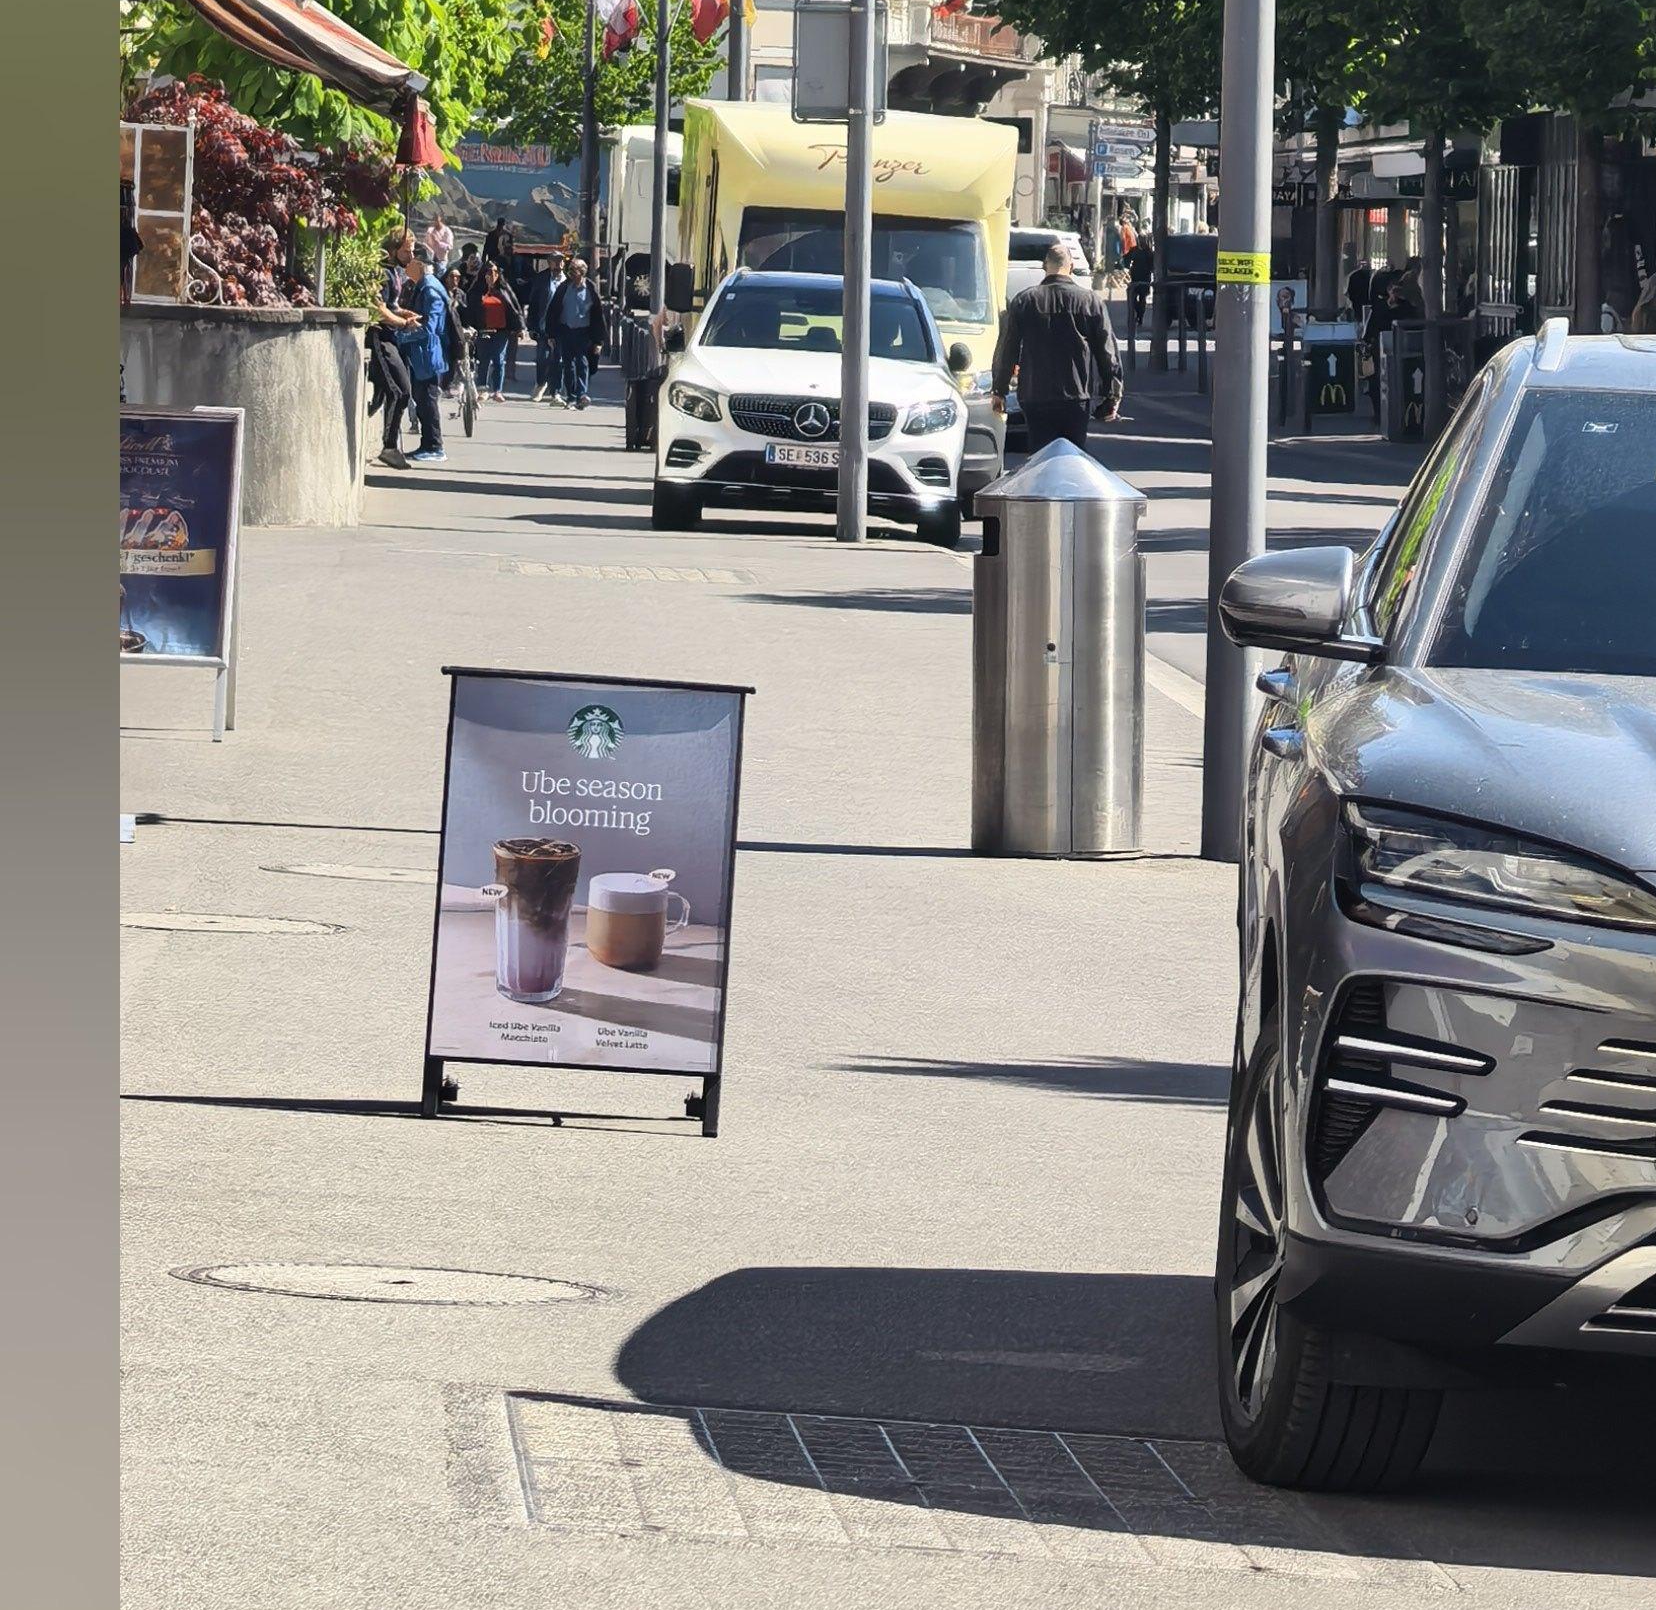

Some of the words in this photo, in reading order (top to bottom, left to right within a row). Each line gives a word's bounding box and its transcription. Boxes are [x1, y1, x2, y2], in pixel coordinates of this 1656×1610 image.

[778, 448, 795, 462] SE
[804, 450, 829, 465] 536
[521, 769, 571, 795] Ube
[575, 778, 663, 801] season
[529, 799, 653, 836] blooming
[651, 872, 671, 880] NEW
[482, 887, 502, 897] NEW
[531, 1023, 561, 1033] Vanilla
[597, 1027, 616, 1037] Ube
[618, 1028, 648, 1039] Vanilla
